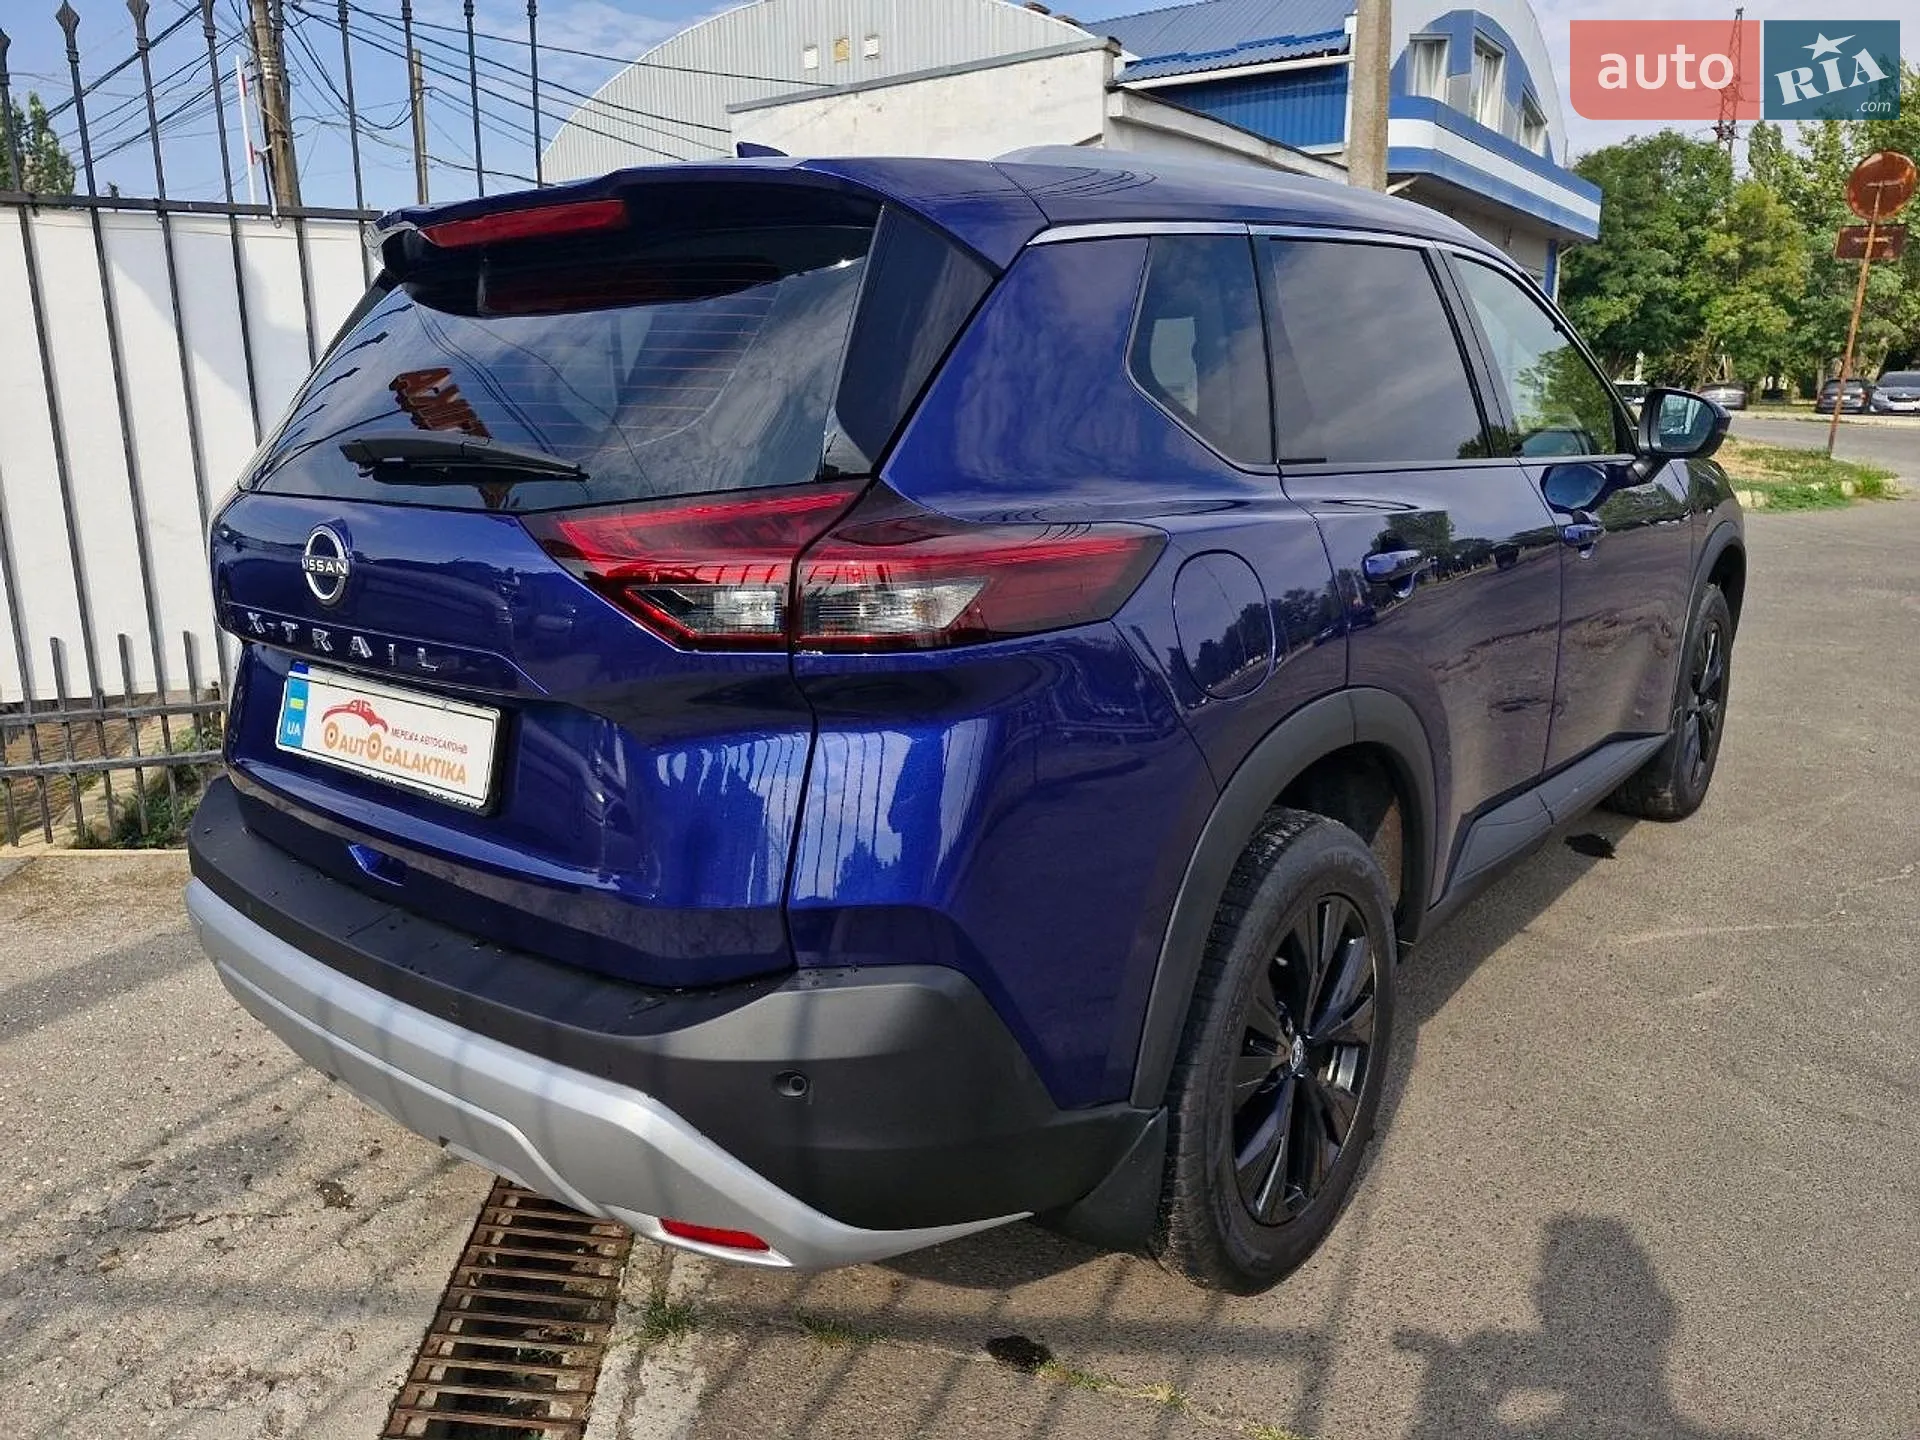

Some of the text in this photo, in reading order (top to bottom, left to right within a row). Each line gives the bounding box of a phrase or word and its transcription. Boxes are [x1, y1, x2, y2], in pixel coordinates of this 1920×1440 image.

[302, 558, 347, 574] NISSAN
[247, 612, 439, 671] X-TRAIL
[287, 721, 301, 736] UA
